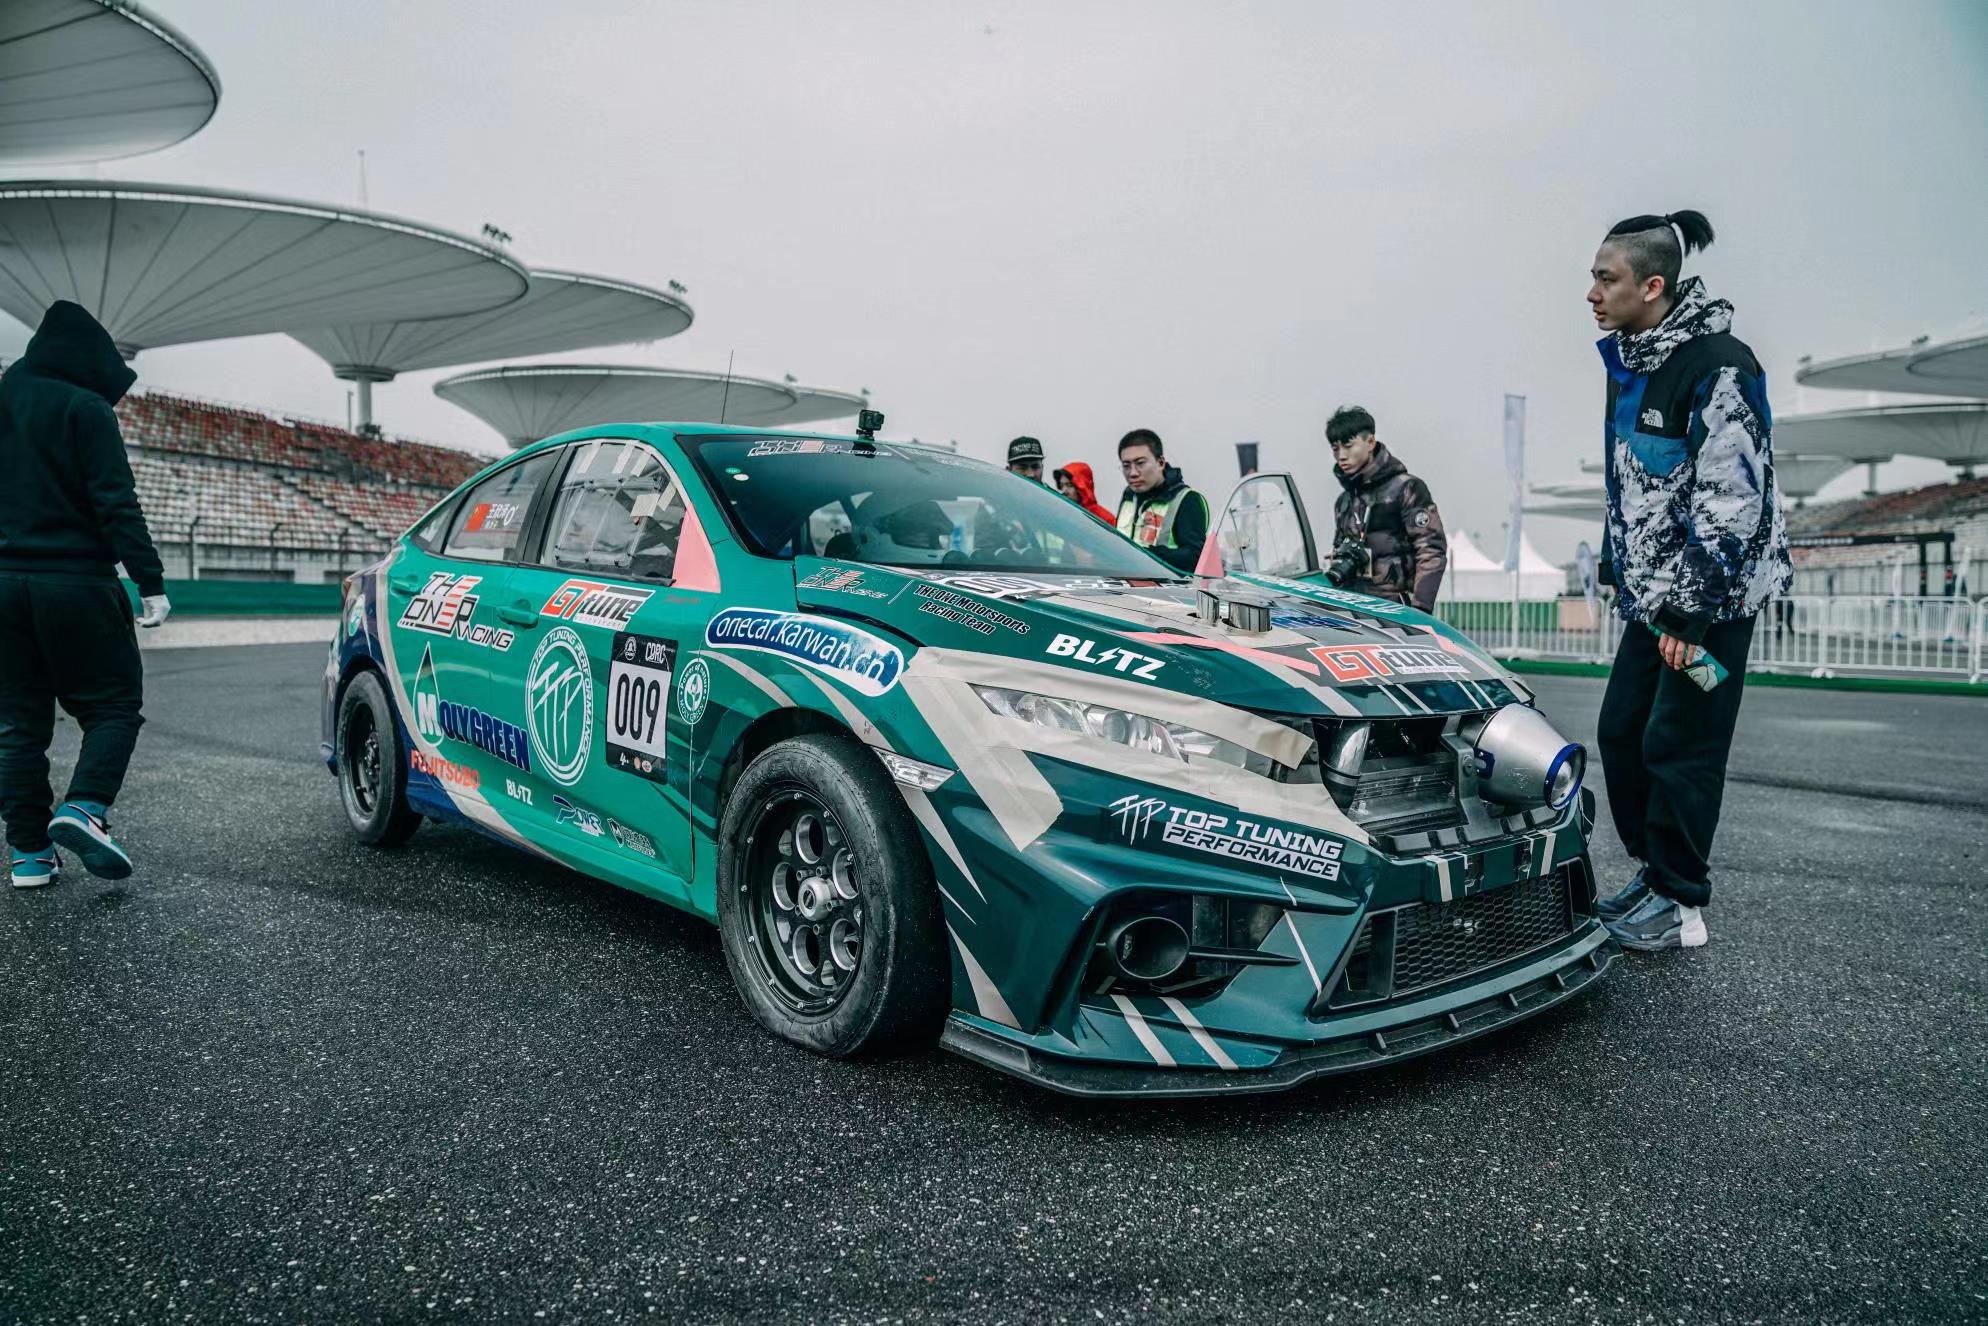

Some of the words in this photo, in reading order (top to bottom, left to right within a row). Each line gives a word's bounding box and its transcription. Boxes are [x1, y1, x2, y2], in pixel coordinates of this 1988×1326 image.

[422, 573, 481, 597] THE
[403, 597, 458, 627] ONE
[913, 584, 937, 598] THE
[933, 589, 960, 605] ONE
[953, 596, 1030, 635] Motorsports
[919, 600, 963, 622] Racing
[959, 613, 996, 635] Team
[534, 641, 549, 663] TOP
[549, 629, 576, 646] TUNING
[716, 617, 886, 682] onecar.karwan.cn
[614, 672, 661, 745] 009
[410, 749, 480, 791] FUJITSUBO
[1165, 825, 1339, 878] PERFORMANCE
[1168, 806, 1230, 832] TOP
[1235, 819, 1343, 860] TUNING
